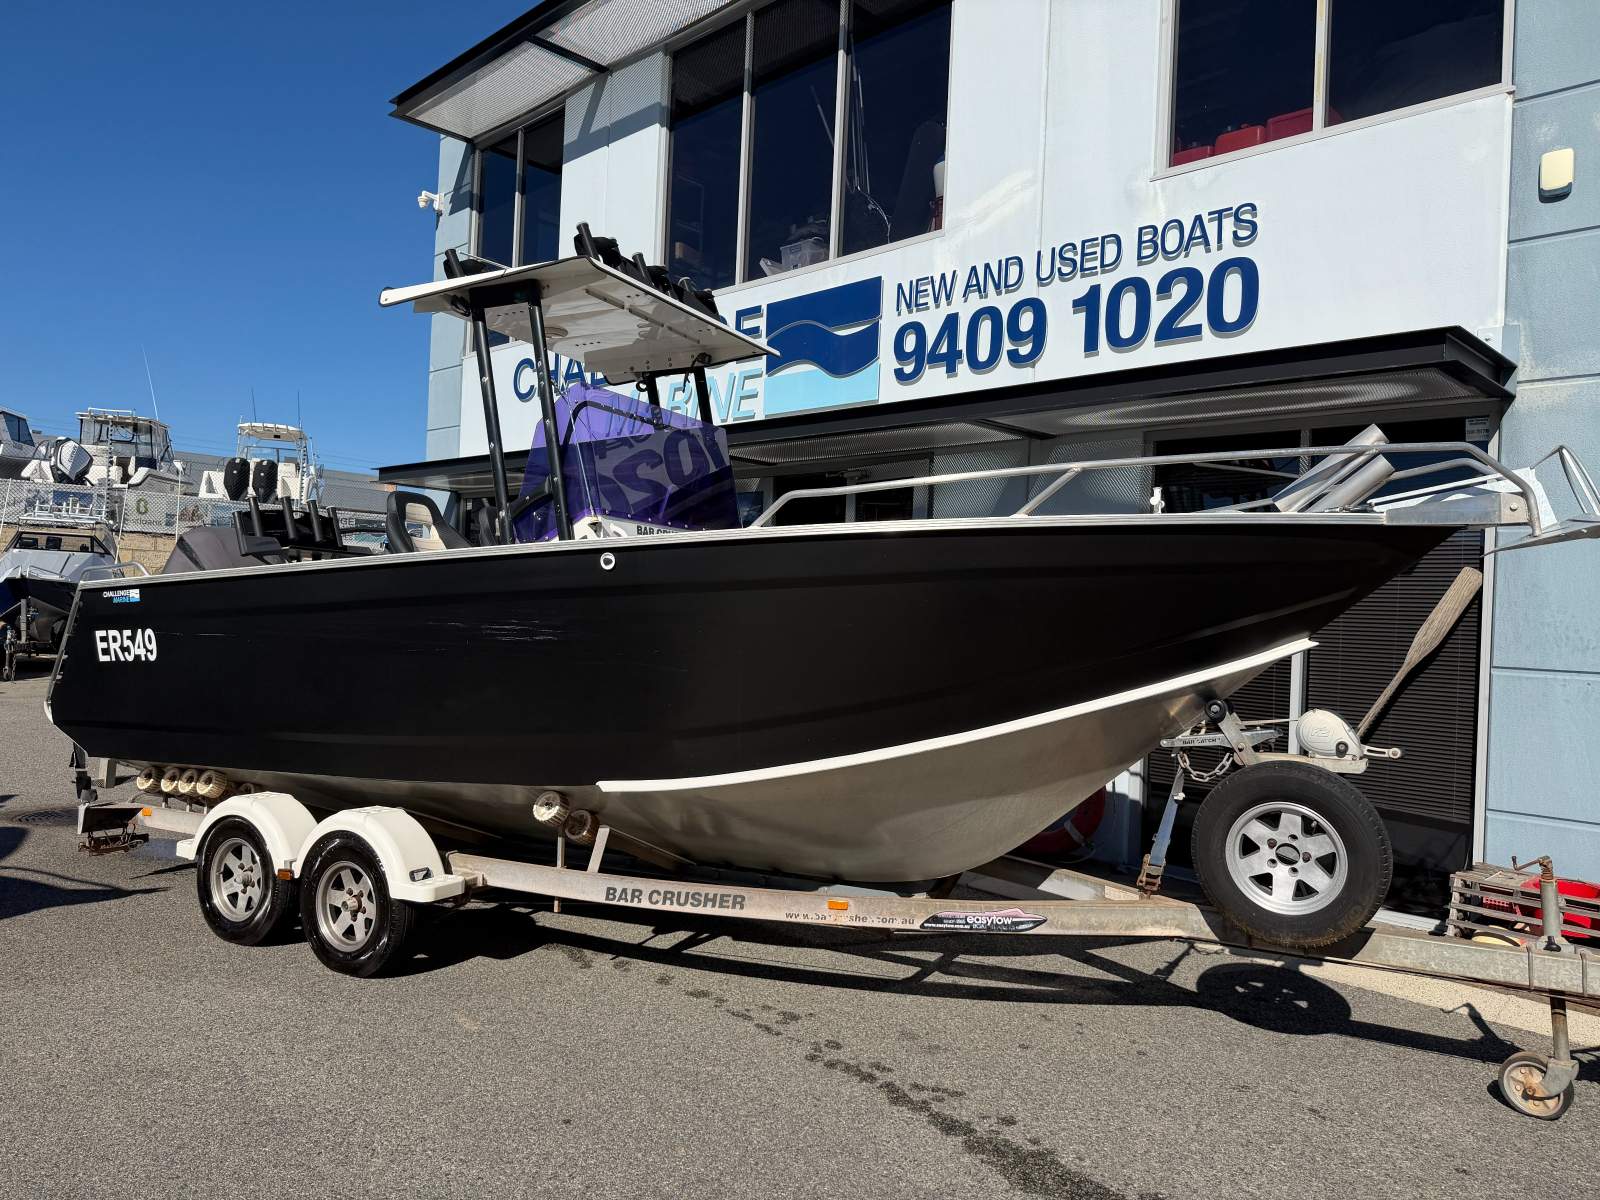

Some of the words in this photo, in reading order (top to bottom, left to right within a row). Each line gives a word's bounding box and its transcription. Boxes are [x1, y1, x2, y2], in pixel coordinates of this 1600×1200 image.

[896, 270, 957, 316] NEW
[962, 255, 1025, 302] AND
[1035, 233, 1123, 287] USED
[1136, 202, 1259, 267] BOATS
[893, 296, 1049, 385] 9409
[1071, 256, 1261, 358] 1020
[95, 628, 157, 662] ER549
[604, 886, 643, 903] BAR
[648, 889, 746, 910] CRUSHER
[966, 914, 1012, 926] easytow
